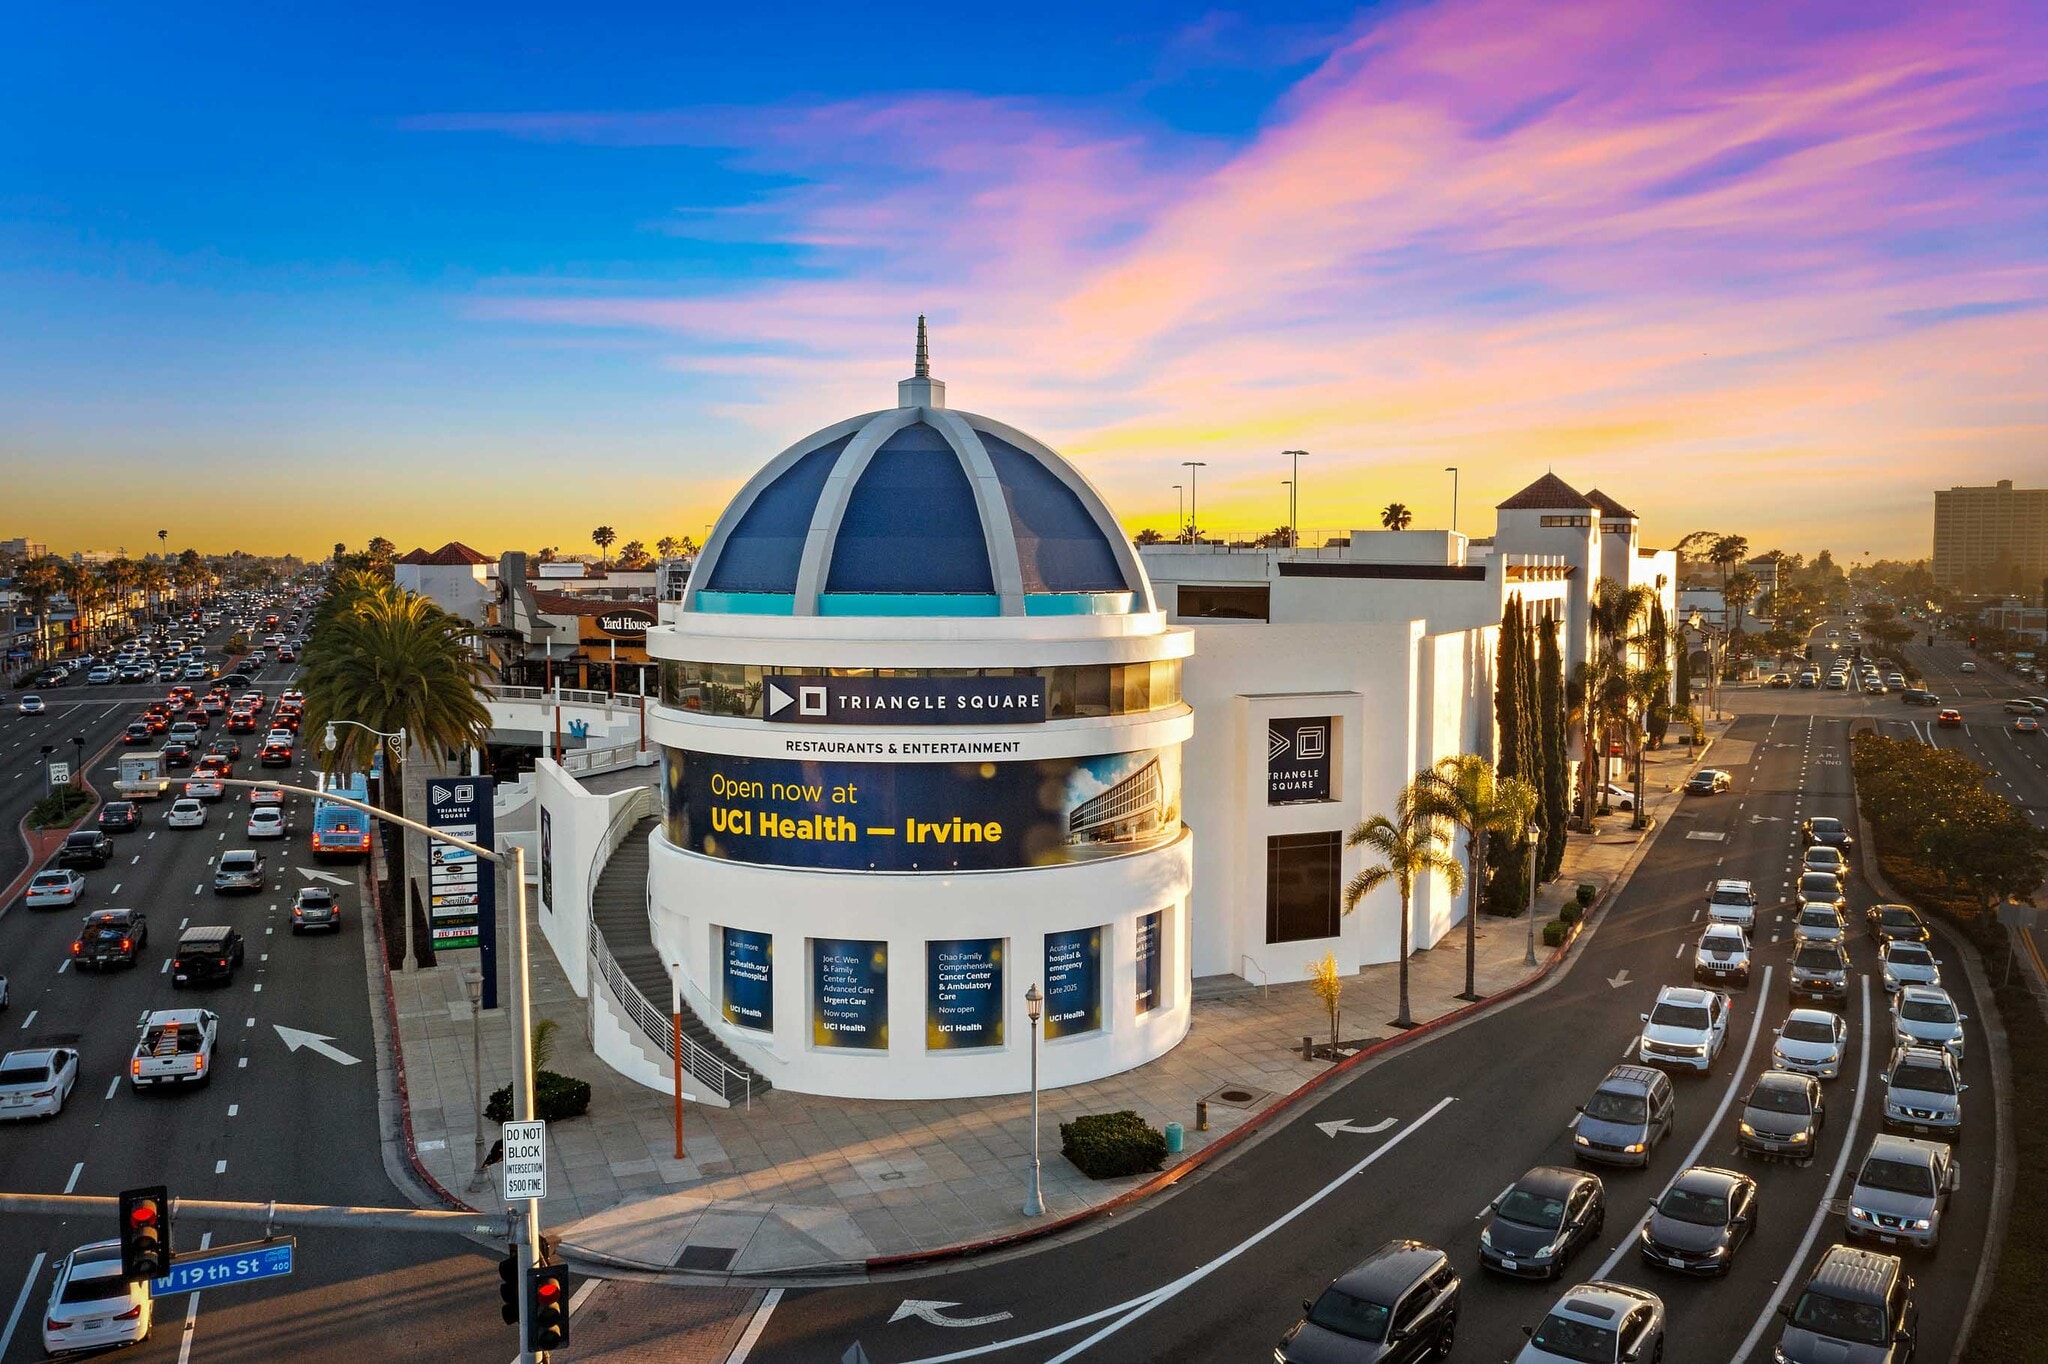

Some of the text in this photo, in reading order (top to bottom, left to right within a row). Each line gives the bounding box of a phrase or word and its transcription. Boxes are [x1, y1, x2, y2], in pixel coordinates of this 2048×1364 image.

[601, 617, 651, 630] Yard House
[838, 693, 1040, 710] TRIANGLE SQUARE
[785, 740, 1020, 754] RESTAURANTS & ENTERTAINMENT
[53, 774, 68, 782] 40
[1267, 769, 1319, 780] TRIANGLE
[711, 773, 858, 804] Open now at
[1272, 780, 1314, 791] SQUARE
[711, 806, 752, 837] UCI
[759, 812, 857, 843] Health
[906, 816, 1003, 843] Irvine
[440, 896, 470, 905] Sevilla
[729, 940, 759, 951] Learn more
[1049, 945, 1068, 953] Acute
[823, 955, 834, 963] Joe
[938, 952, 983, 961] Chao Family
[1049, 951, 1075, 962] hospital
[830, 965, 853, 974] Family
[938, 962, 993, 972] Comprehensive
[1049, 961, 1083, 972] emergency
[729, 968, 768, 981] irvinehospital
[823, 975, 858, 983] Center for
[938, 972, 991, 981] Cancer Center
[1049, 973, 1067, 981] room
[823, 984, 874, 994] Advanced Care
[946, 982, 992, 990] Ambulatory
[1049, 983, 1078, 995] Late 2025
[823, 996, 867, 1005] Urgent Care
[729, 1004, 762, 1018] UCI Health
[823, 1009, 840, 1017] Now
[957, 1006, 975, 1014] open
[1049, 1009, 1085, 1023] UCI Health
[823, 1022, 866, 1032] UCI Health
[938, 1023, 982, 1032] UCI Health
[506, 1127, 541, 1141] DO NOT
[508, 1145, 540, 1158] BLOCK
[507, 1162, 543, 1174] INTERSECTION
[508, 1178, 542, 1192] $500 FINE
[272, 1261, 290, 1271] 400
[157, 1258, 260, 1289] W 19th St
